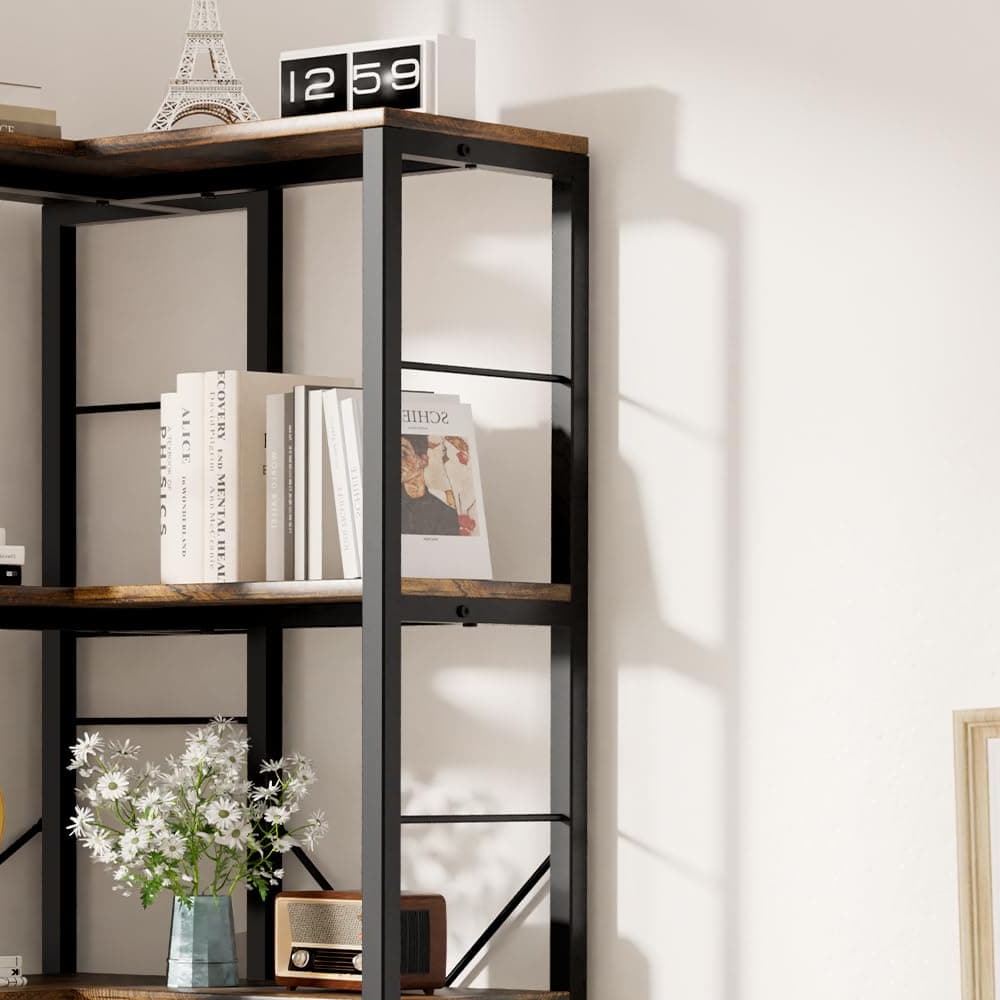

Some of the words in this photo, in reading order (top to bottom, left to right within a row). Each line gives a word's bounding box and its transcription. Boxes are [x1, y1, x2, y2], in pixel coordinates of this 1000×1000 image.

[289, 67, 335, 103] 12
[353, 58, 420, 95] 59
[181, 407, 191, 464] ALICE
[217, 473, 226, 536] MENTAL
